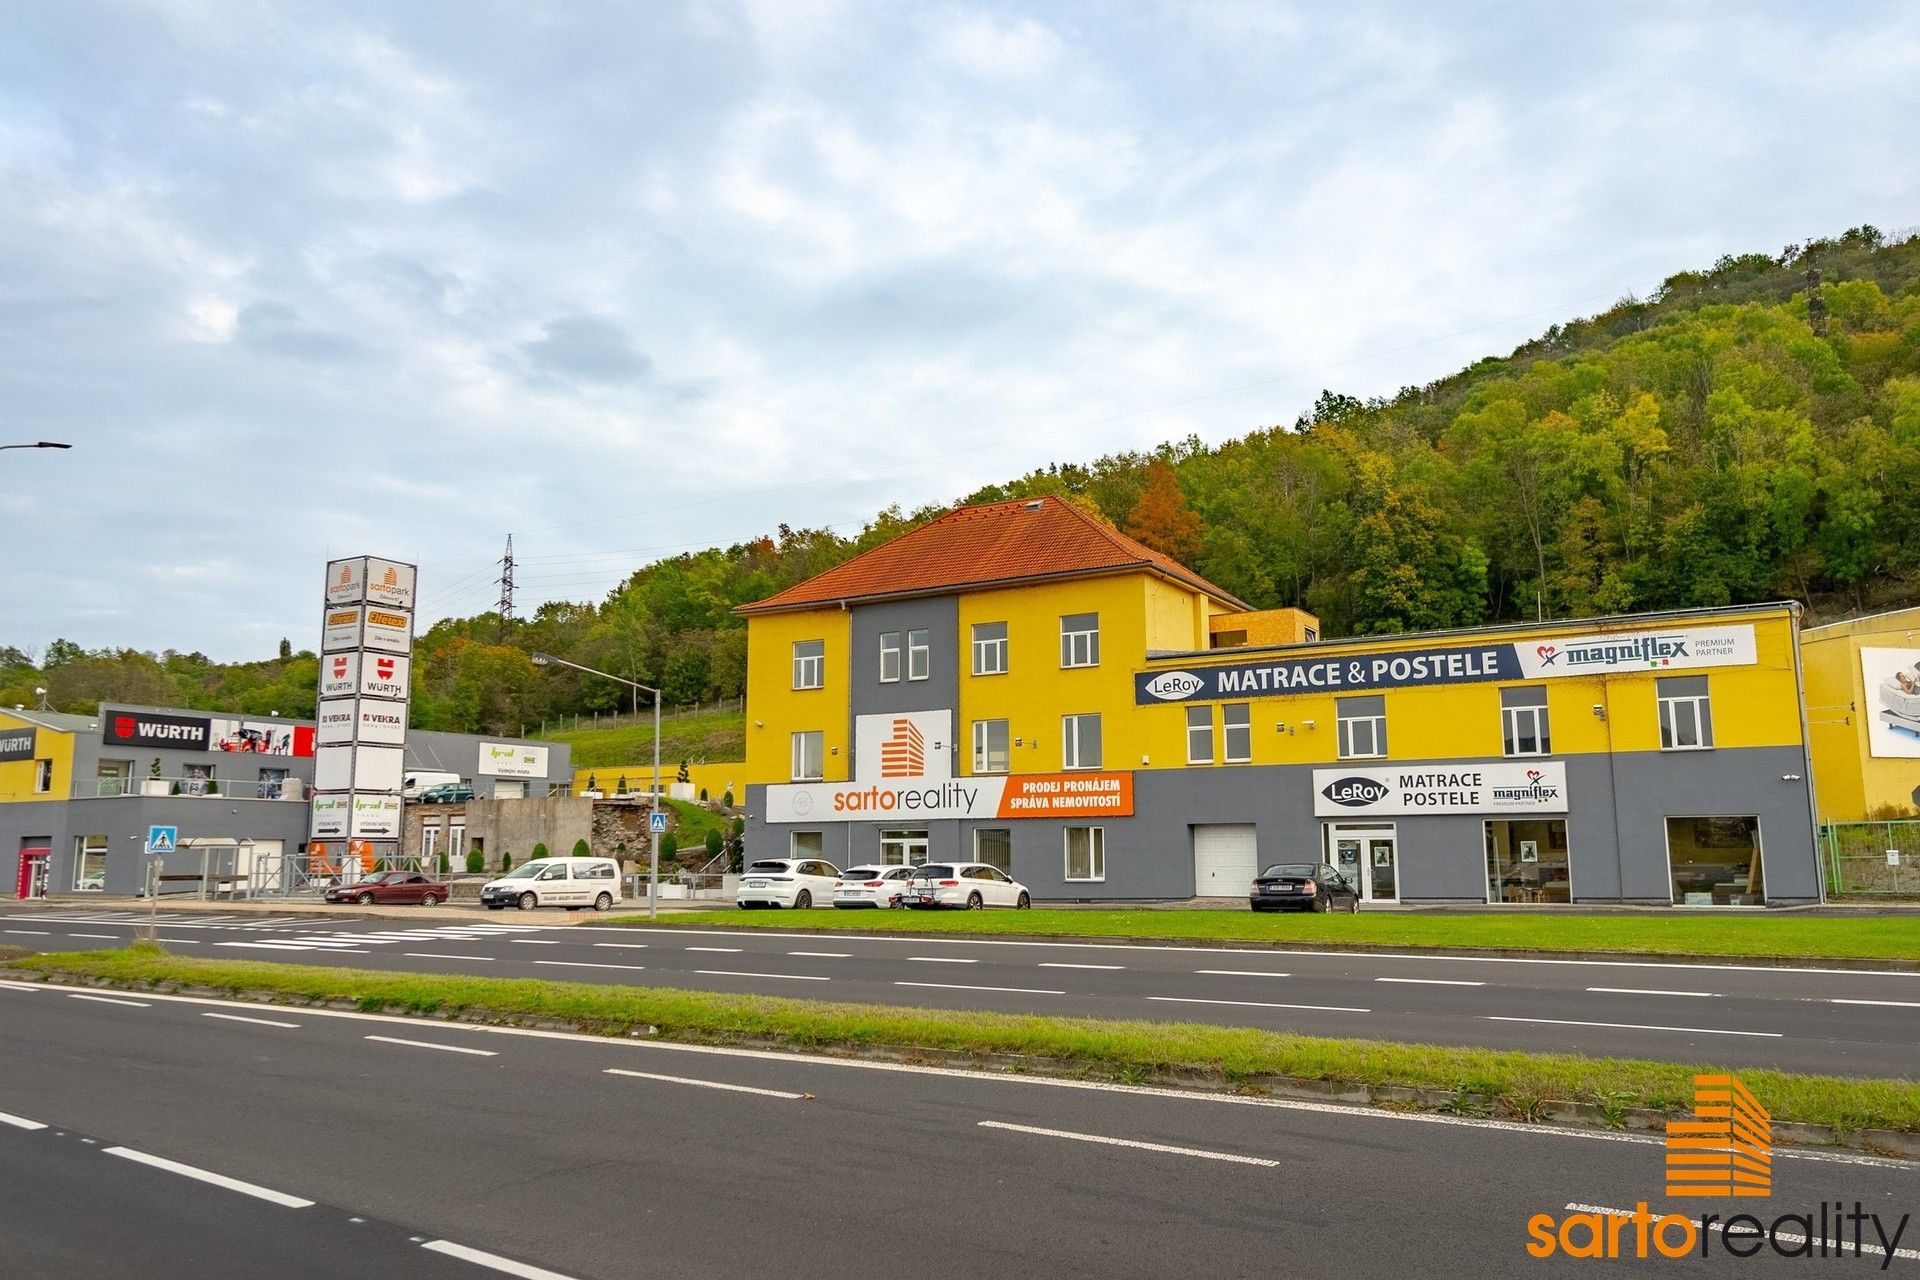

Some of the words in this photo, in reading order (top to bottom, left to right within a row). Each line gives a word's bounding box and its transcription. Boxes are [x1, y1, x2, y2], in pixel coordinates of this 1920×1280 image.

[370, 582, 410, 597] sartopark
[1567, 637, 1690, 665] magniflex
[1695, 638, 1735, 648] PREMIUM
[1695, 647, 1734, 657] PARTNER
[1154, 678, 1200, 694] LeRoy
[1218, 663, 1341, 693] MATRACE
[1348, 661, 1366, 684] &
[1373, 651, 1499, 682] POSTELE
[326, 682, 352, 692] WÜRTH
[367, 682, 401, 694] WÜRTH
[328, 713, 351, 723] VEKRA
[371, 714, 400, 724] VEKRA
[138, 722, 204, 741] WÜRTH
[1023, 781, 1061, 794] PRODEJ
[1063, 777, 1121, 792] PRONÁJEM
[1400, 773, 1482, 788] MATRACE
[834, 782, 978, 814] sartoreality
[1331, 783, 1385, 801] LeRoy
[1403, 791, 1480, 806] POSTELE
[1493, 786, 1559, 801] magniflex
[1010, 794, 1050, 809] SPRÁVA
[1052, 792, 1121, 808] NEMOVITOSTÍ
